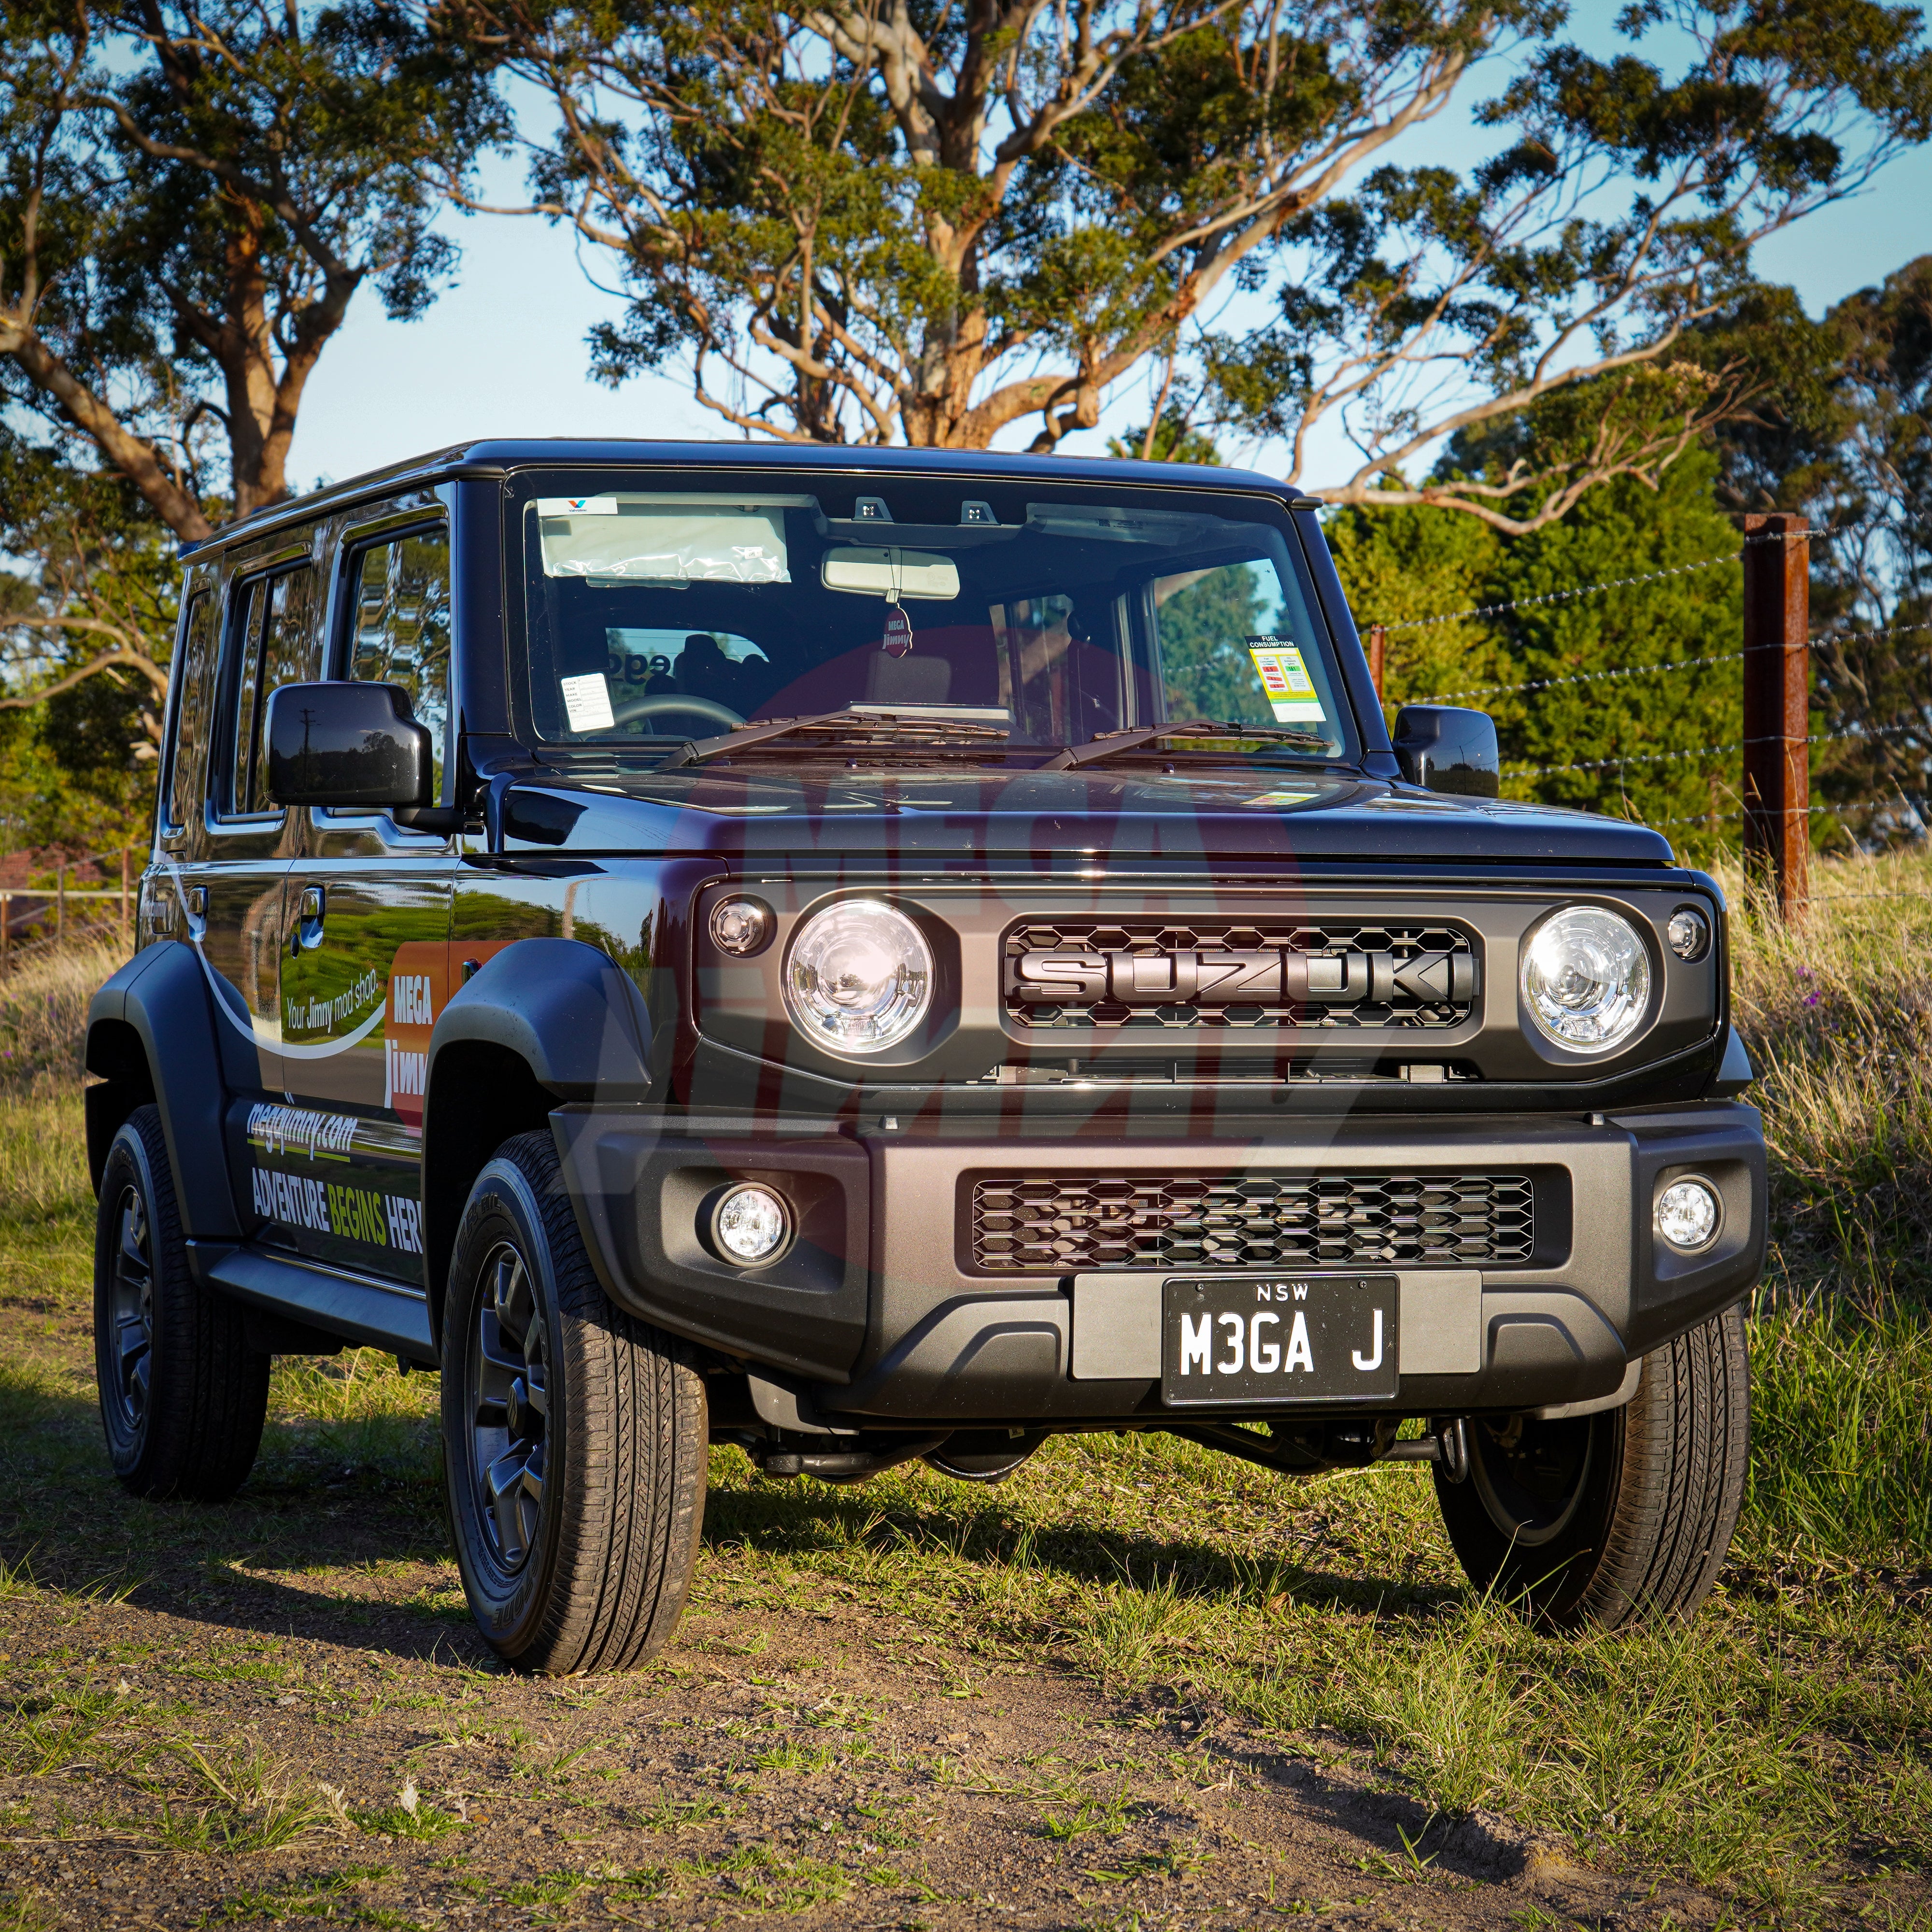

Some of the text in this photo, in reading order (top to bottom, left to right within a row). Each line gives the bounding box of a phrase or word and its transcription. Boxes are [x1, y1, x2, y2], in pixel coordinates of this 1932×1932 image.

[881, 634, 910, 650] Jimny
[888, 619, 905, 631] MEGA
[287, 968, 379, 1034] Your Jimny mod shop.
[394, 975, 433, 1025] MEGA
[1014, 952, 1474, 1003] SUZUKI
[247, 1091, 358, 1161] megajimny.com
[252, 1167, 330, 1233] ADVENTURE
[327, 1183, 386, 1247] BEGINS
[1256, 1283, 1309, 1302] NSW
[1179, 1308, 1383, 1376] M3GA J
